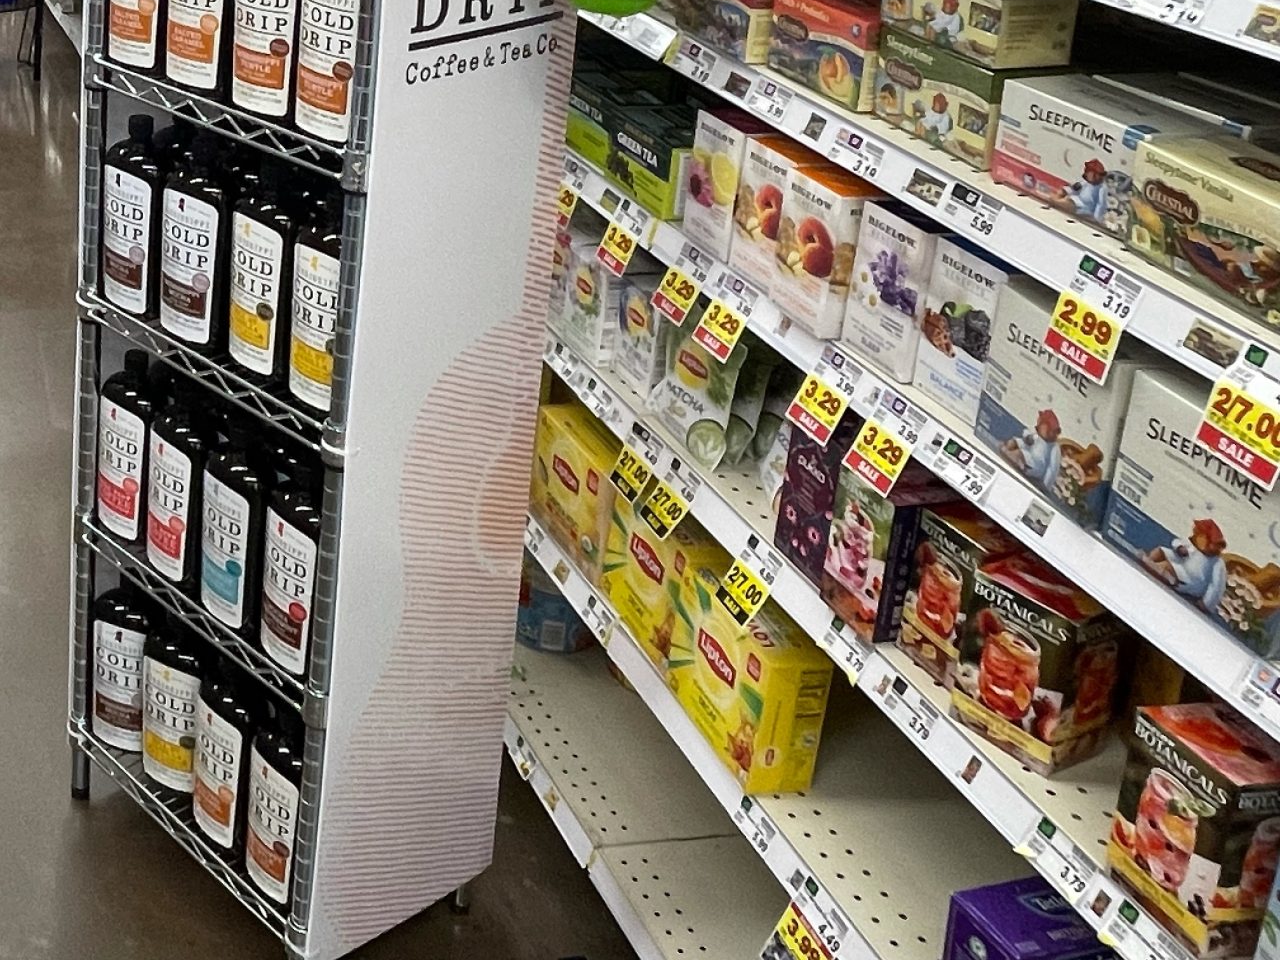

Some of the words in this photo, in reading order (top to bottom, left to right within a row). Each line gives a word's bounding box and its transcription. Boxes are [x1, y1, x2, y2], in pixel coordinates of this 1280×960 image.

[236, 6, 289, 33] DRIP
[303, 1, 355, 32] COLD
[301, 27, 353, 56] DRIP
[405, 51, 481, 86] Coffee
[499, 39, 533, 67] Tea
[1028, 103, 1115, 155] SLEEPYTIME
[1145, 183, 1197, 221] CELESTIAL
[163, 218, 210, 248] COLD
[868, 213, 918, 249] BIGELOW
[969, 214, 995, 236] 5.99
[162, 242, 209, 269] DRIP
[665, 271, 696, 301] 3.29
[941, 254, 996, 291] BIGELOW
[708, 304, 741, 336] 3.29
[1058, 299, 1113, 346] 2.99
[1102, 294, 1131, 320] 3.19
[1059, 342, 1089, 368] SALE
[804, 379, 842, 417] 3.29
[863, 426, 905, 466] 3.29
[1216, 438, 1255, 468] SALE
[152, 466, 185, 495] OLD
[856, 462, 880, 483] SALE
[206, 505, 242, 537] OLD
[269, 546, 308, 579] OLD
[974, 580, 1069, 643] BOTANICALS
[699, 630, 736, 685] Lipton
[145, 683, 196, 716] COLD
[907, 716, 931, 741] 3.79
[200, 734, 235, 766] OLD
[1135, 720, 1228, 806] BOTANICALS
[255, 786, 291, 822] OLD
[253, 804, 290, 838] RIP
[1059, 865, 1087, 893] 3.79
